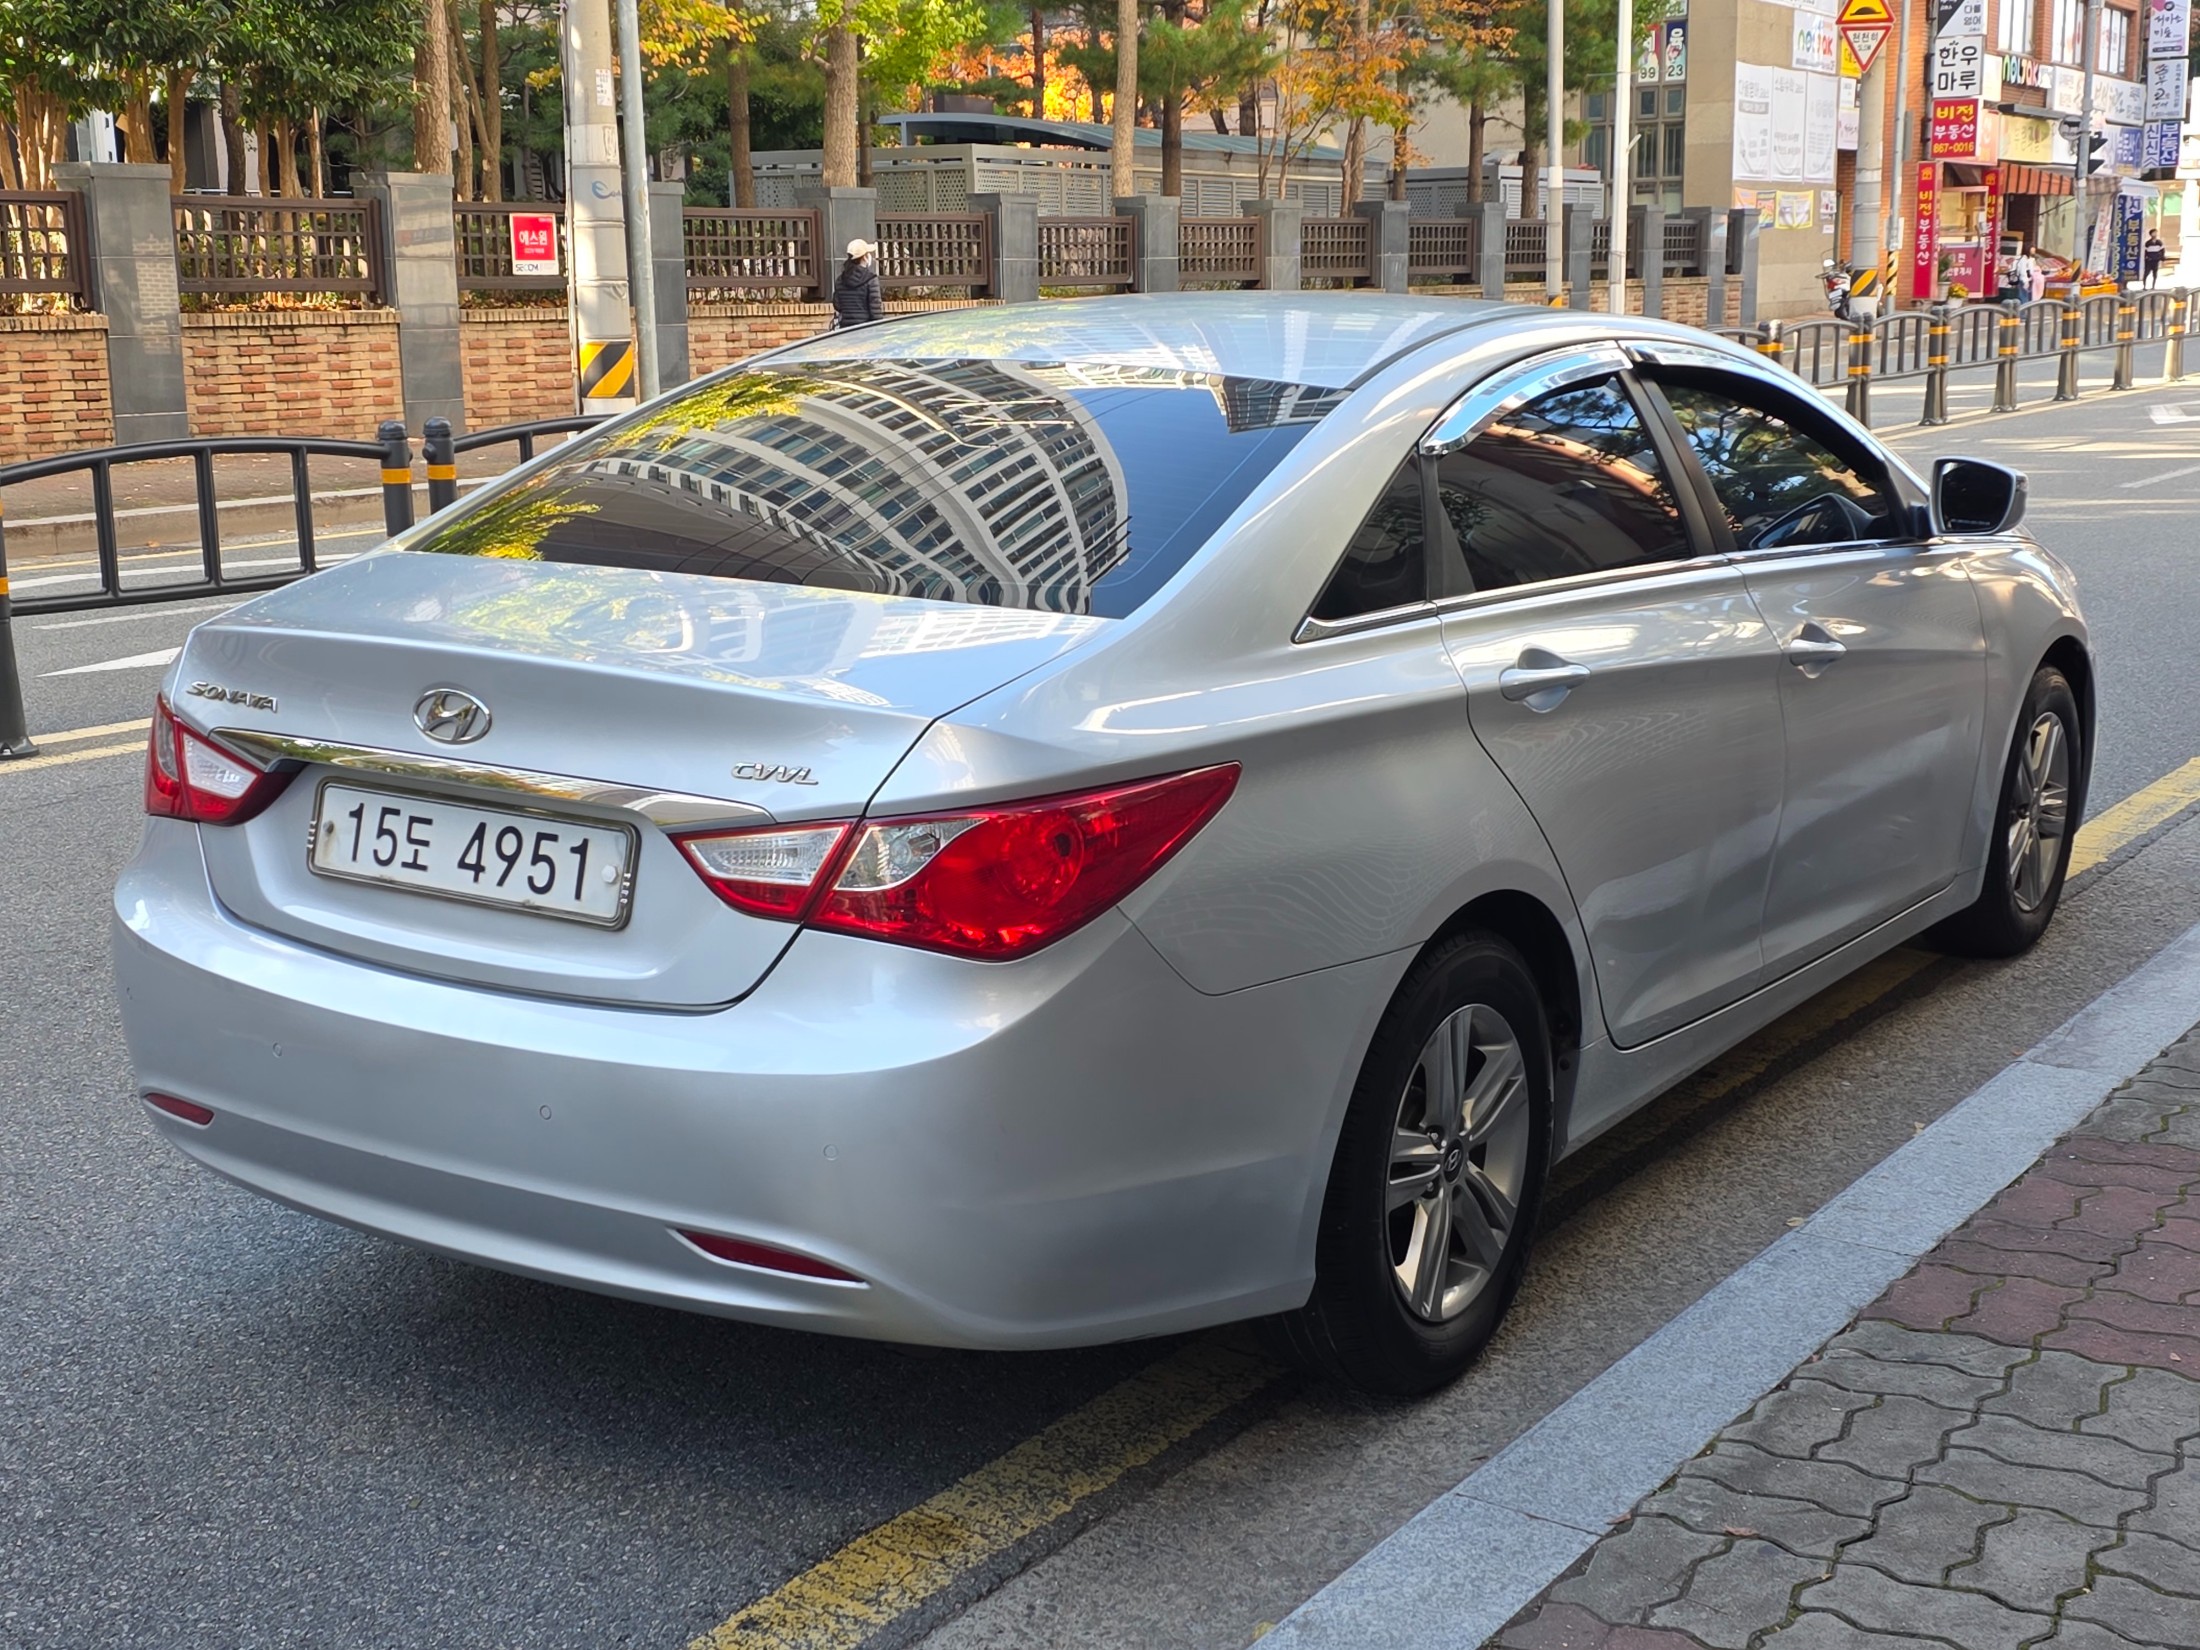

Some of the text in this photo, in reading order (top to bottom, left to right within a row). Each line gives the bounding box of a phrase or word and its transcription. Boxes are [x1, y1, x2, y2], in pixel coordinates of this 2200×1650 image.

[1939, 44, 1978, 67] 한우
[1667, 64, 1684, 77] 23
[1937, 70, 1977, 91] 마루
[1935, 104, 1975, 122] 비전
[1933, 123, 1976, 140] 부동산
[518, 230, 548, 246] 에스원
[1917, 190, 1933, 266] 비전 부동산
[186, 681, 278, 713] SONATA
[731, 762, 819, 786] CVVL
[348, 802, 590, 902] 15도 4951
